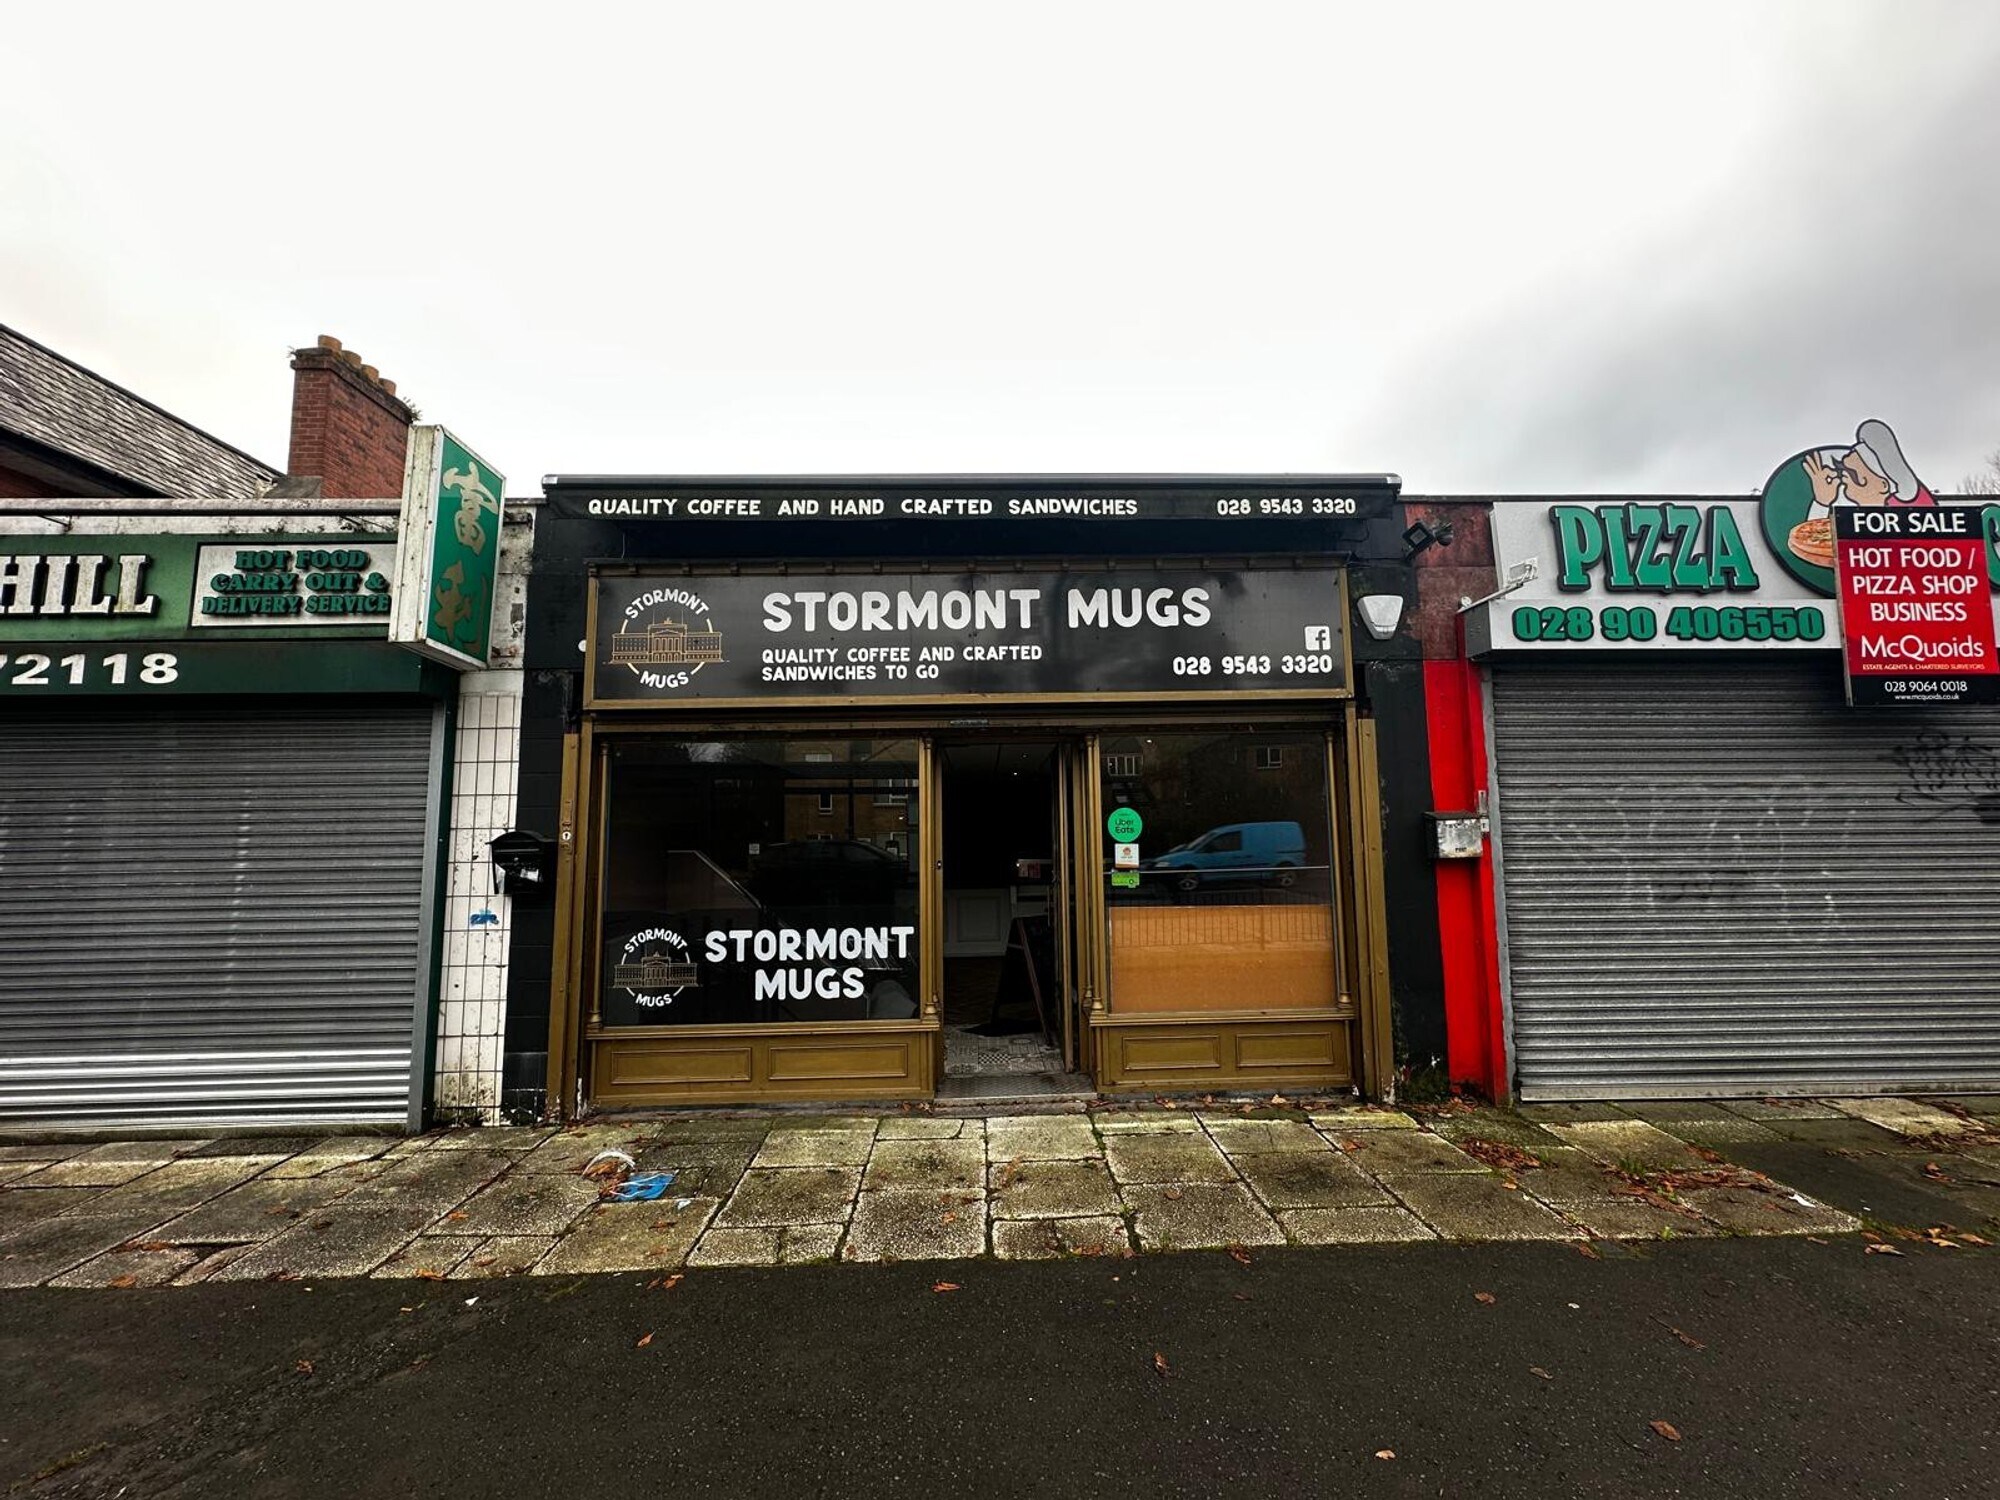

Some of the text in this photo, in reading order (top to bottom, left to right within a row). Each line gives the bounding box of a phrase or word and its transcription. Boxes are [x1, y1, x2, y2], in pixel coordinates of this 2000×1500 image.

[588, 498, 1138, 515] QUALITY COFFEE AND HAND CRAFTED SANDWICHES
[1217, 498, 1356, 515] 028 9543 3320
[1853, 512, 1967, 533] FOR SALE
[1550, 504, 1759, 592] PIZZA
[1848, 547, 1892, 568] HOT
[1900, 547, 1961, 568] FOOD
[235, 550, 368, 570] HOT FOOD
[211, 572, 389, 593] CARRY OUT &
[1853, 575, 1978, 595] PIZZA SHOP
[202, 594, 391, 614] DELIVERY SERVICE
[625, 588, 709, 618] STORMONT
[762, 587, 1211, 632] STORMONT MUGS
[1870, 602, 1967, 622] BUSINESS
[1512, 607, 1825, 641] 028 90 406550
[762, 645, 1042, 663] QUALITY COFFEE AND CRAFTED
[1861, 634, 1984, 661] McQuoids
[0, 653, 178, 684] 2118
[762, 664, 939, 681] SANDWICHES TO GO
[1172, 655, 1333, 675] 028 9543 3320
[640, 671, 689, 688] MUGS
[1884, 681, 1968, 692] 028 9064 0018
[1115, 818, 1134, 826] Uber
[624, 927, 688, 953] STORMONT
[705, 926, 915, 963] STORMONT
[755, 967, 865, 1001] MUGS
[635, 993, 672, 1007] MUGS
